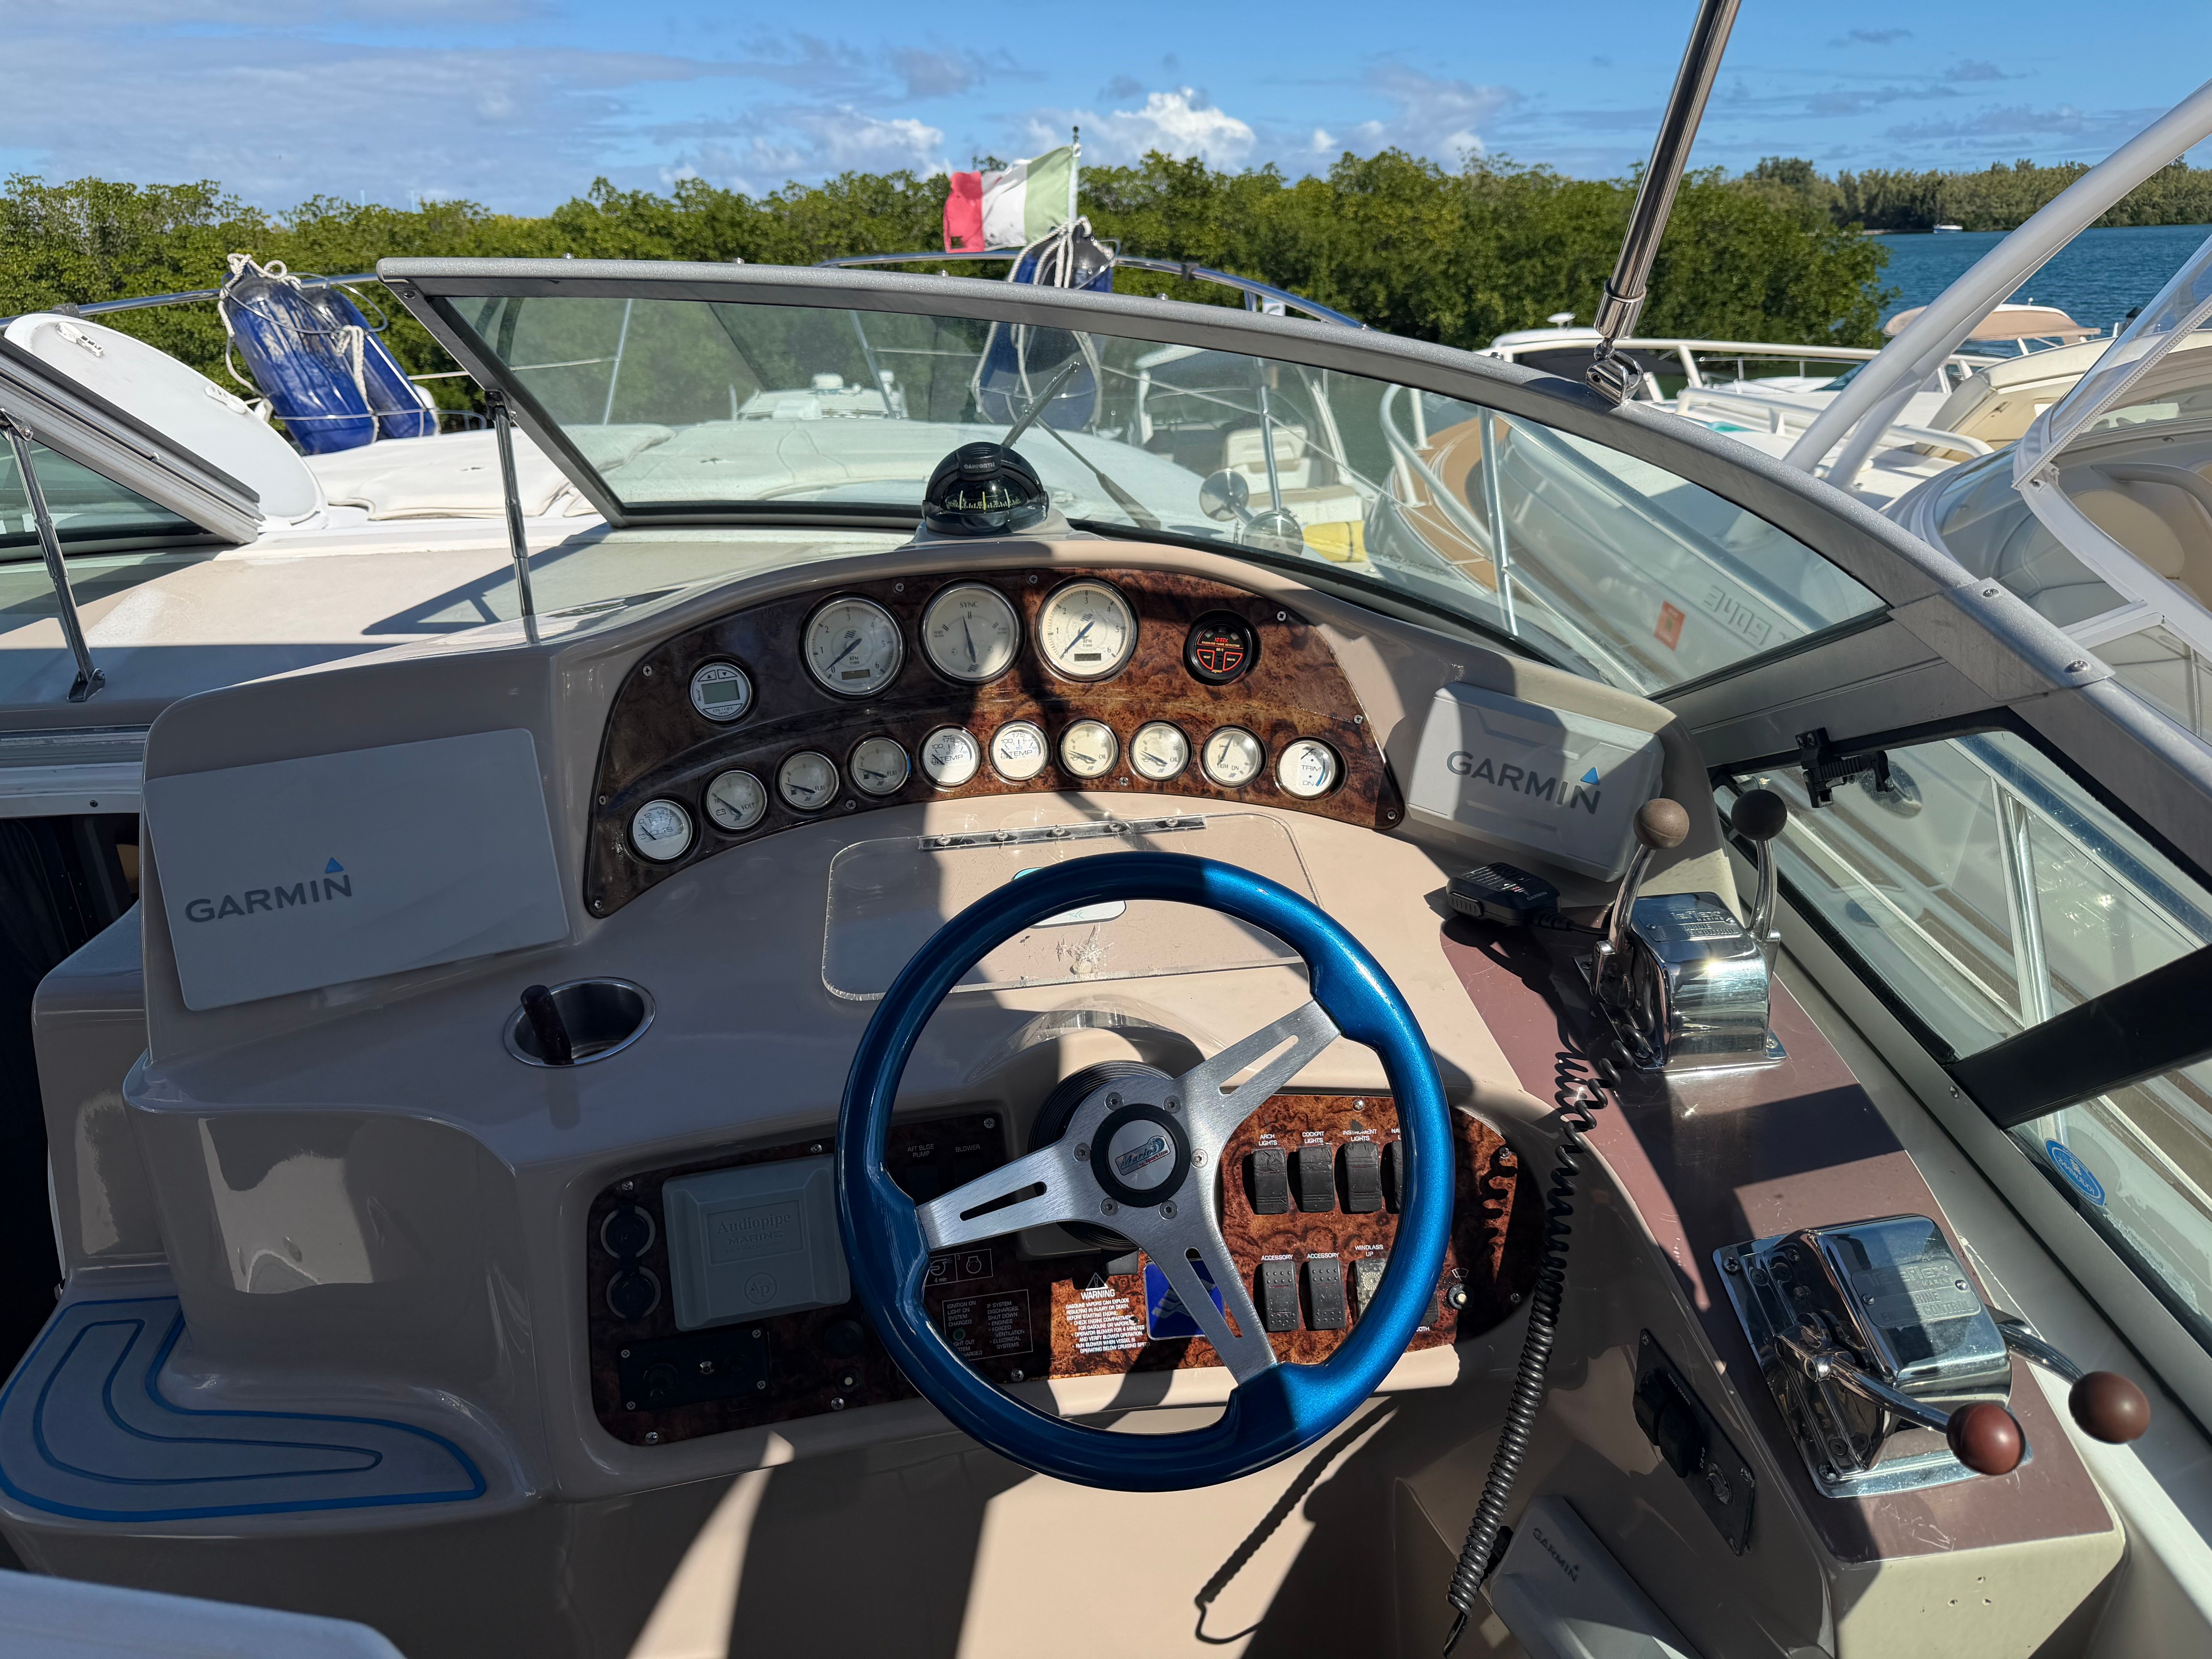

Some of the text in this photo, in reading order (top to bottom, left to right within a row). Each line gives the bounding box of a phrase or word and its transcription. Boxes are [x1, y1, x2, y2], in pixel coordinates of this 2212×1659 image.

[1447, 750, 1601, 814] GARMIN
[185, 874, 352, 923] GARMIN
[1527, 891, 1547, 901] GARMIN
[718, 1213, 791, 1234] Audiopipe
[728, 1230, 783, 1245] MARINE
[749, 1281, 770, 1297] Ap
[1922, 1278, 1953, 1286] MARINE
[1080, 1289, 1115, 1300] WARNING
[1914, 1291, 1941, 1304] RINE
[1922, 1299, 1974, 1317] CONTROL
[995, 1329, 1025, 1338] VENTILATION
[1533, 1527, 1577, 1582] GARMIN
